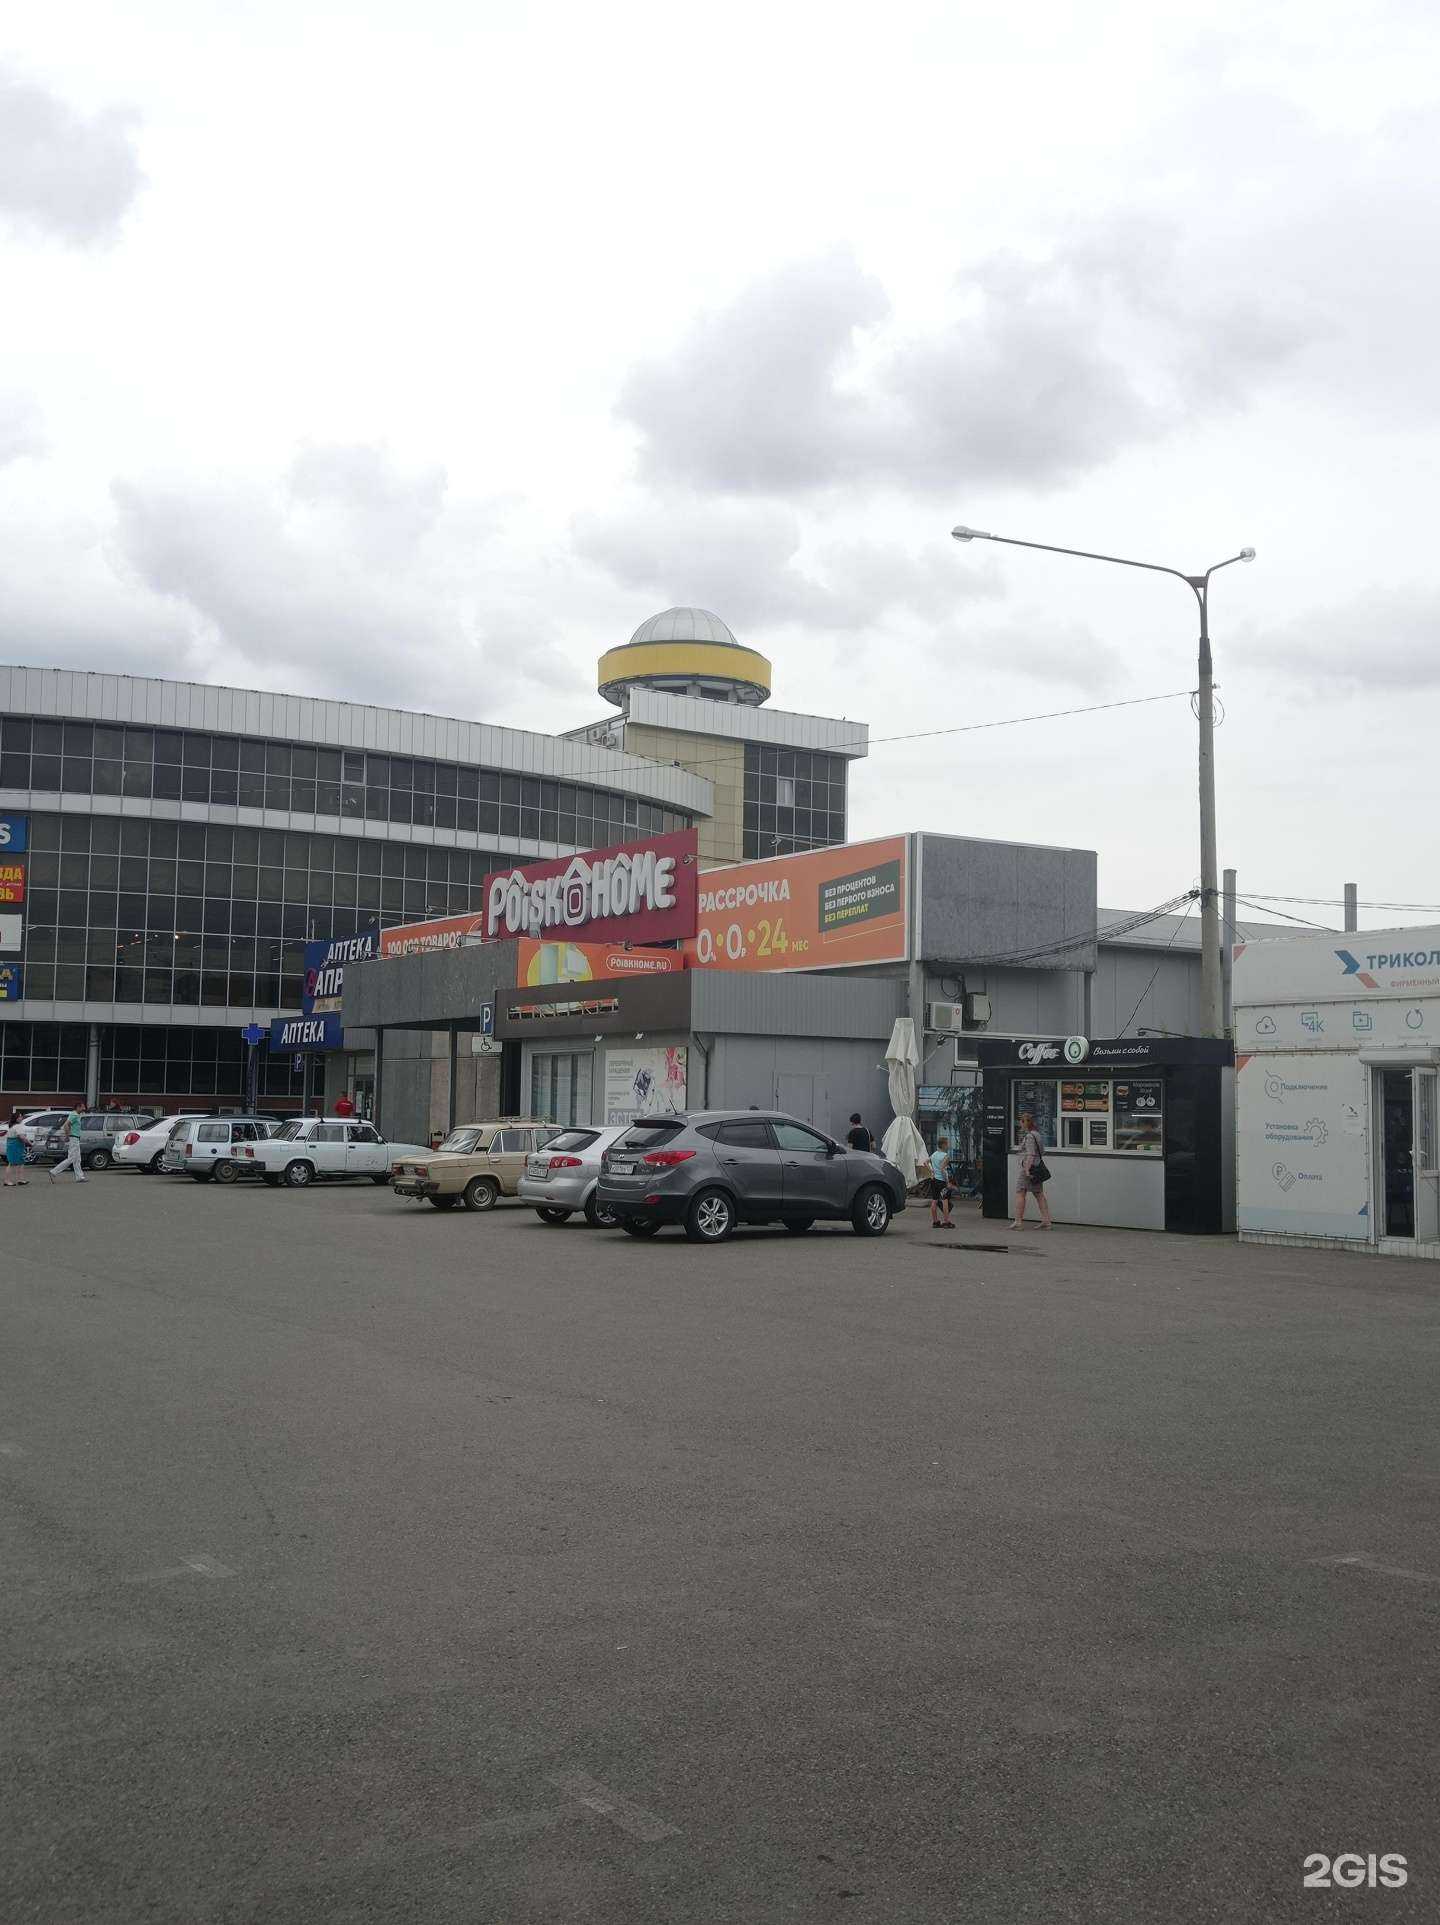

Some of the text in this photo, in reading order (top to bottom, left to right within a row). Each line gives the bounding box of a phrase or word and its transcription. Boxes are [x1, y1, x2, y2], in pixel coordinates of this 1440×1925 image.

[698, 879, 790, 913] РАССРОЧКА
[825, 876, 876, 898] БЕЗ ПРОЦЕНТОВ
[825, 883, 895, 910] БЕЗ ПЕРВОГО ВЗНОСА
[825, 904, 869, 923] БЕЗ ПЕРЕПЛАТ
[327, 936, 372, 961] АПТЕКА
[757, 918, 788, 956] 24
[792, 939, 809, 952] МЕС
[1366, 950, 1440, 970] ТРИКОЛ
[281, 1020, 325, 1045] АПТЕКА
